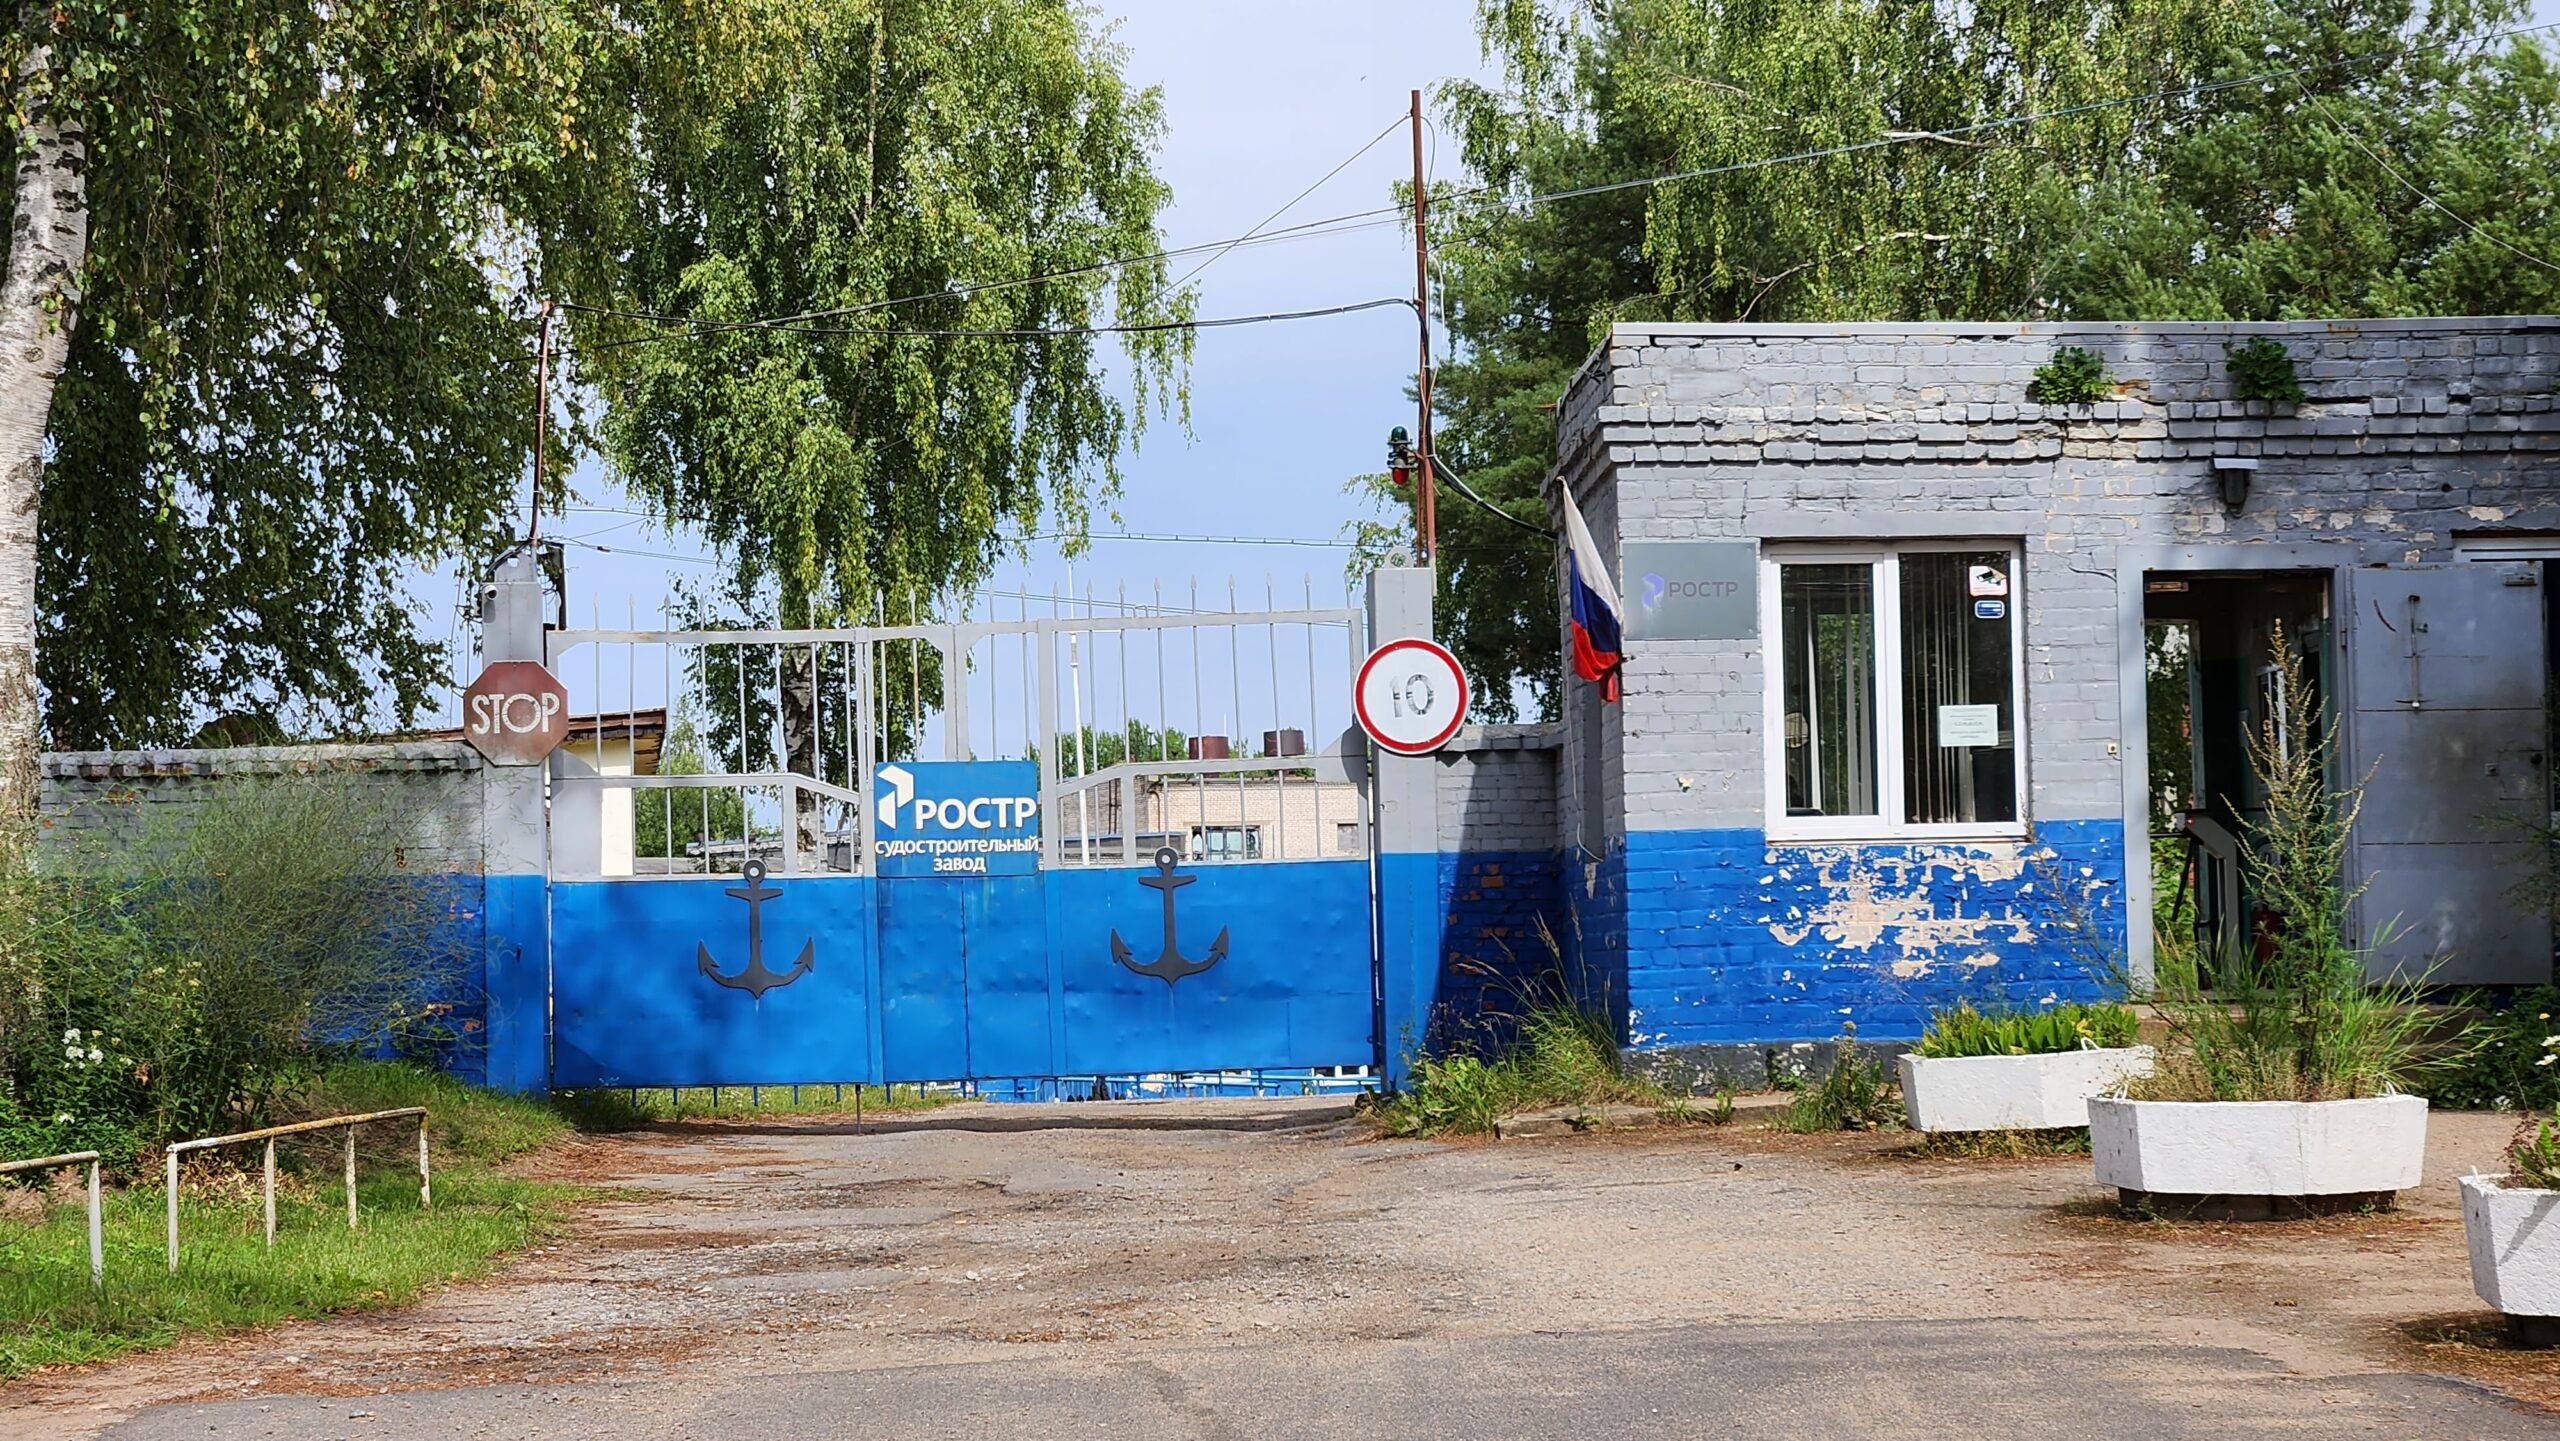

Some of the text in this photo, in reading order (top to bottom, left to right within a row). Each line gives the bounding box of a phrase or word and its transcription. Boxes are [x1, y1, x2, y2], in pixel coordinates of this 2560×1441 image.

[1668, 581, 1739, 598] РОСТР
[1390, 673, 1434, 719] 10
[471, 692, 560, 735] STOP
[915, 797, 1037, 830] РОСТР
[874, 835, 1039, 857] судостроительный
[933, 857, 987, 873] завод
